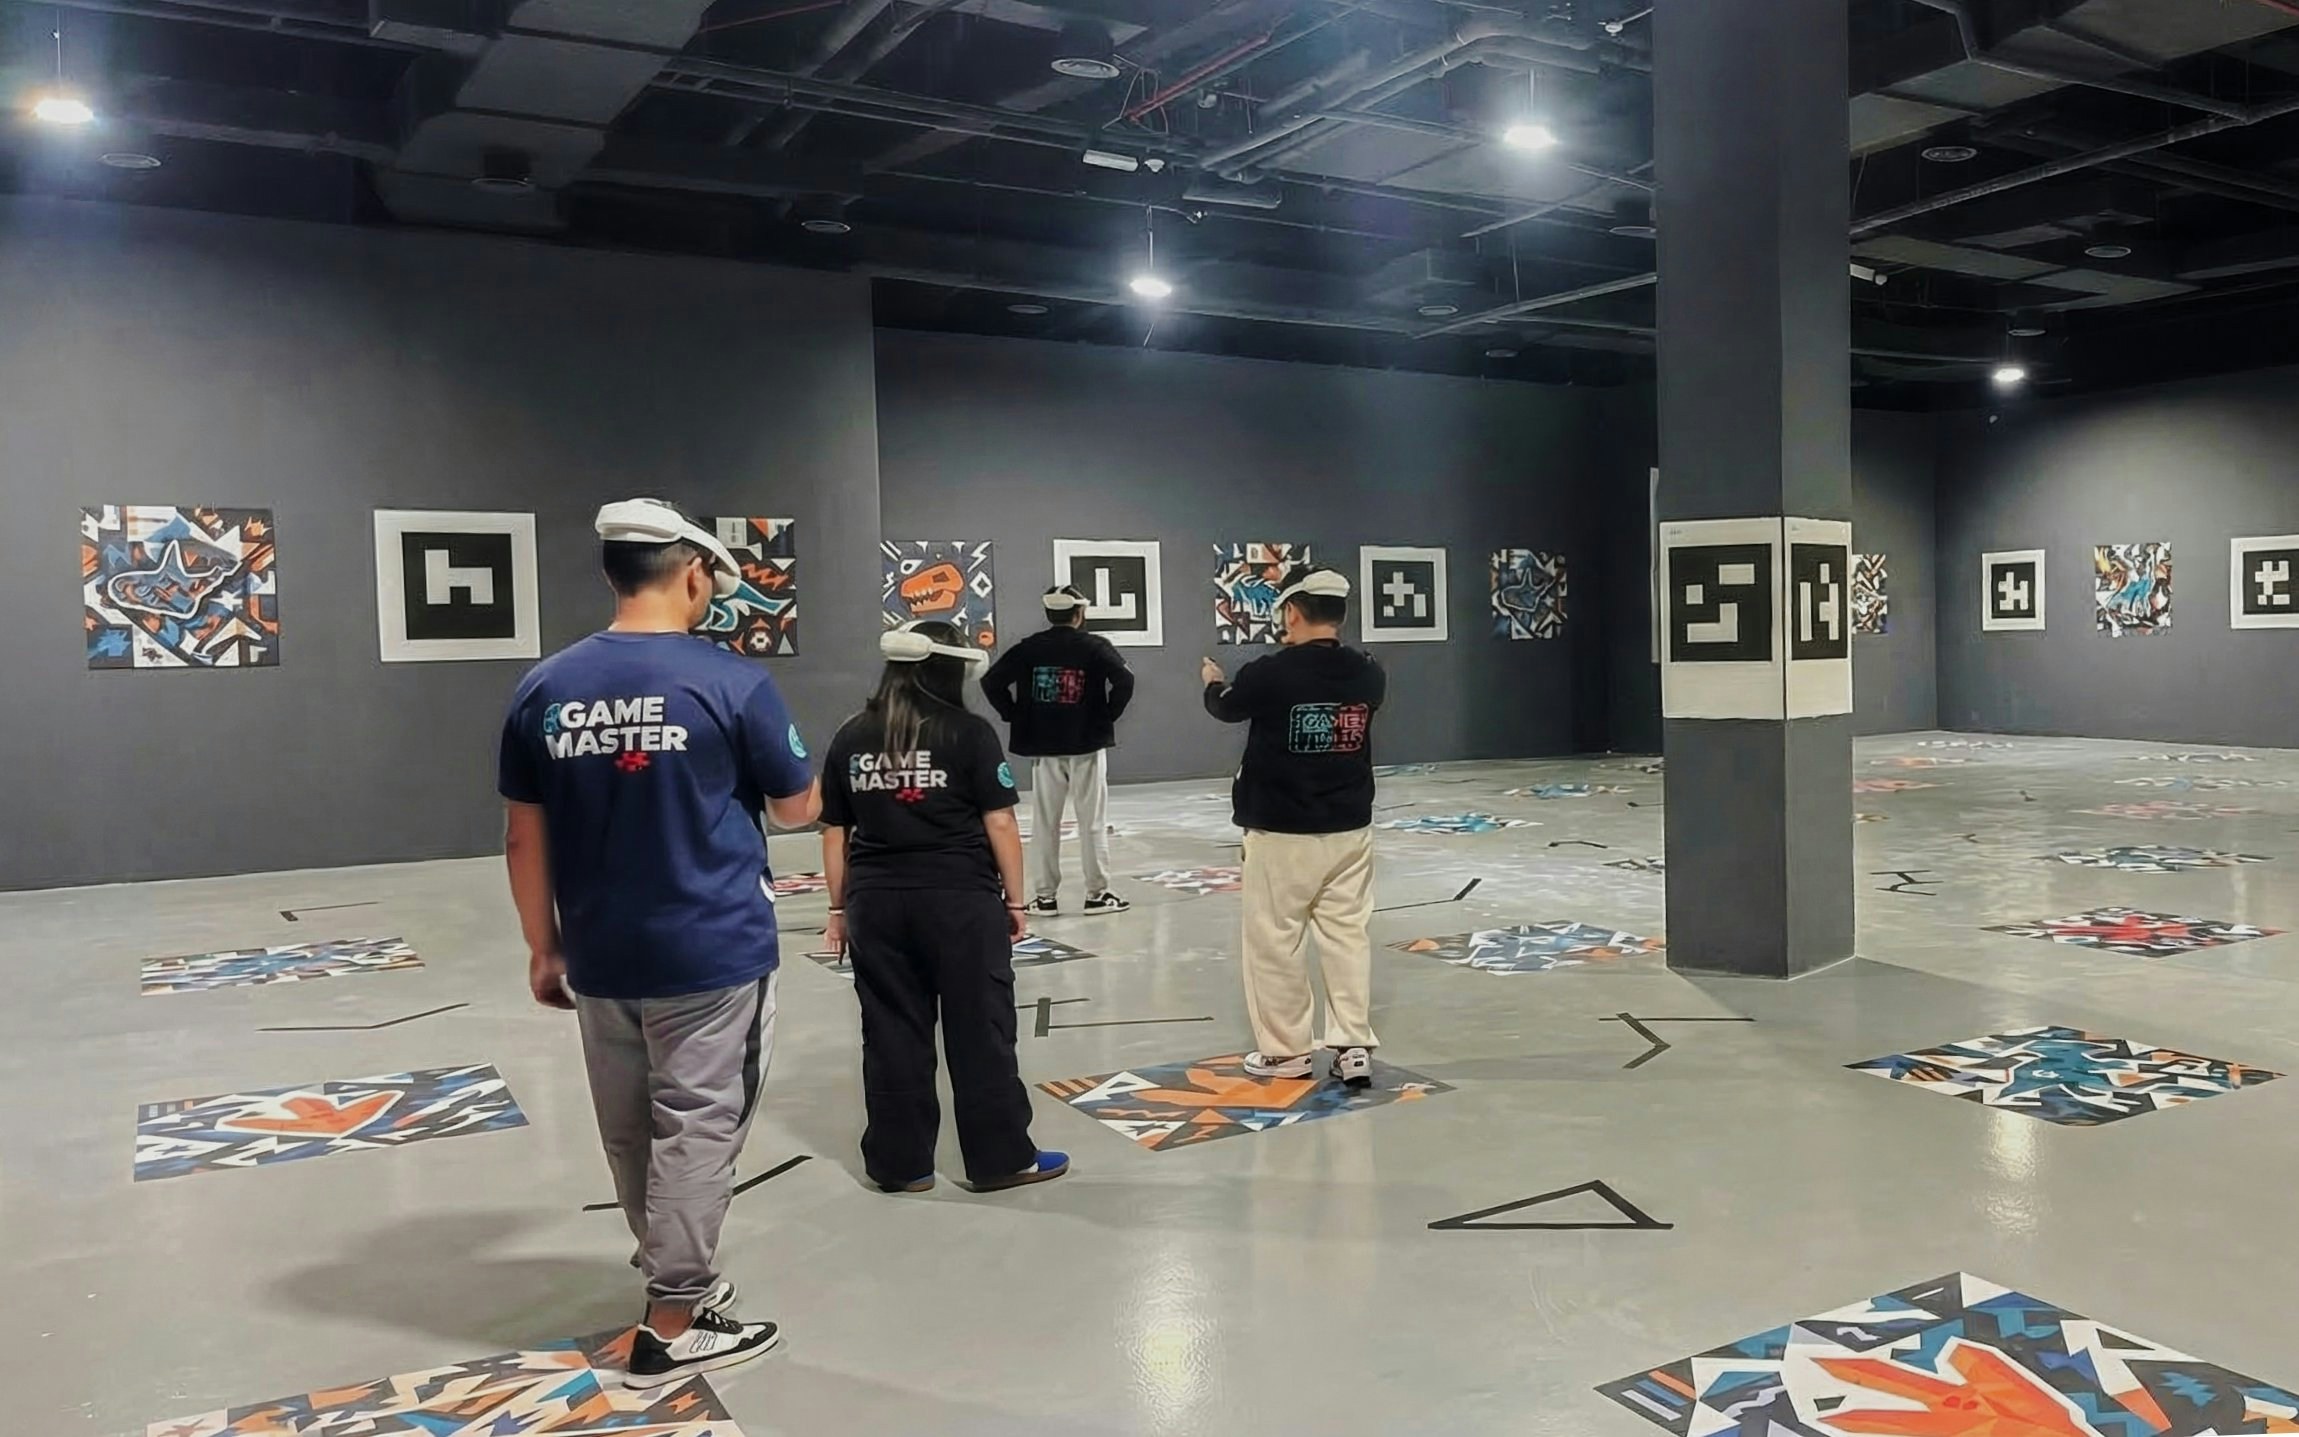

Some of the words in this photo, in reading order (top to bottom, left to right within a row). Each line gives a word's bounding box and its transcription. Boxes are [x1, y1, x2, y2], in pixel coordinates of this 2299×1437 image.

[559, 696, 664, 728] GAME
[545, 725, 689, 760] MASTER
[849, 770, 948, 793] MASTER
